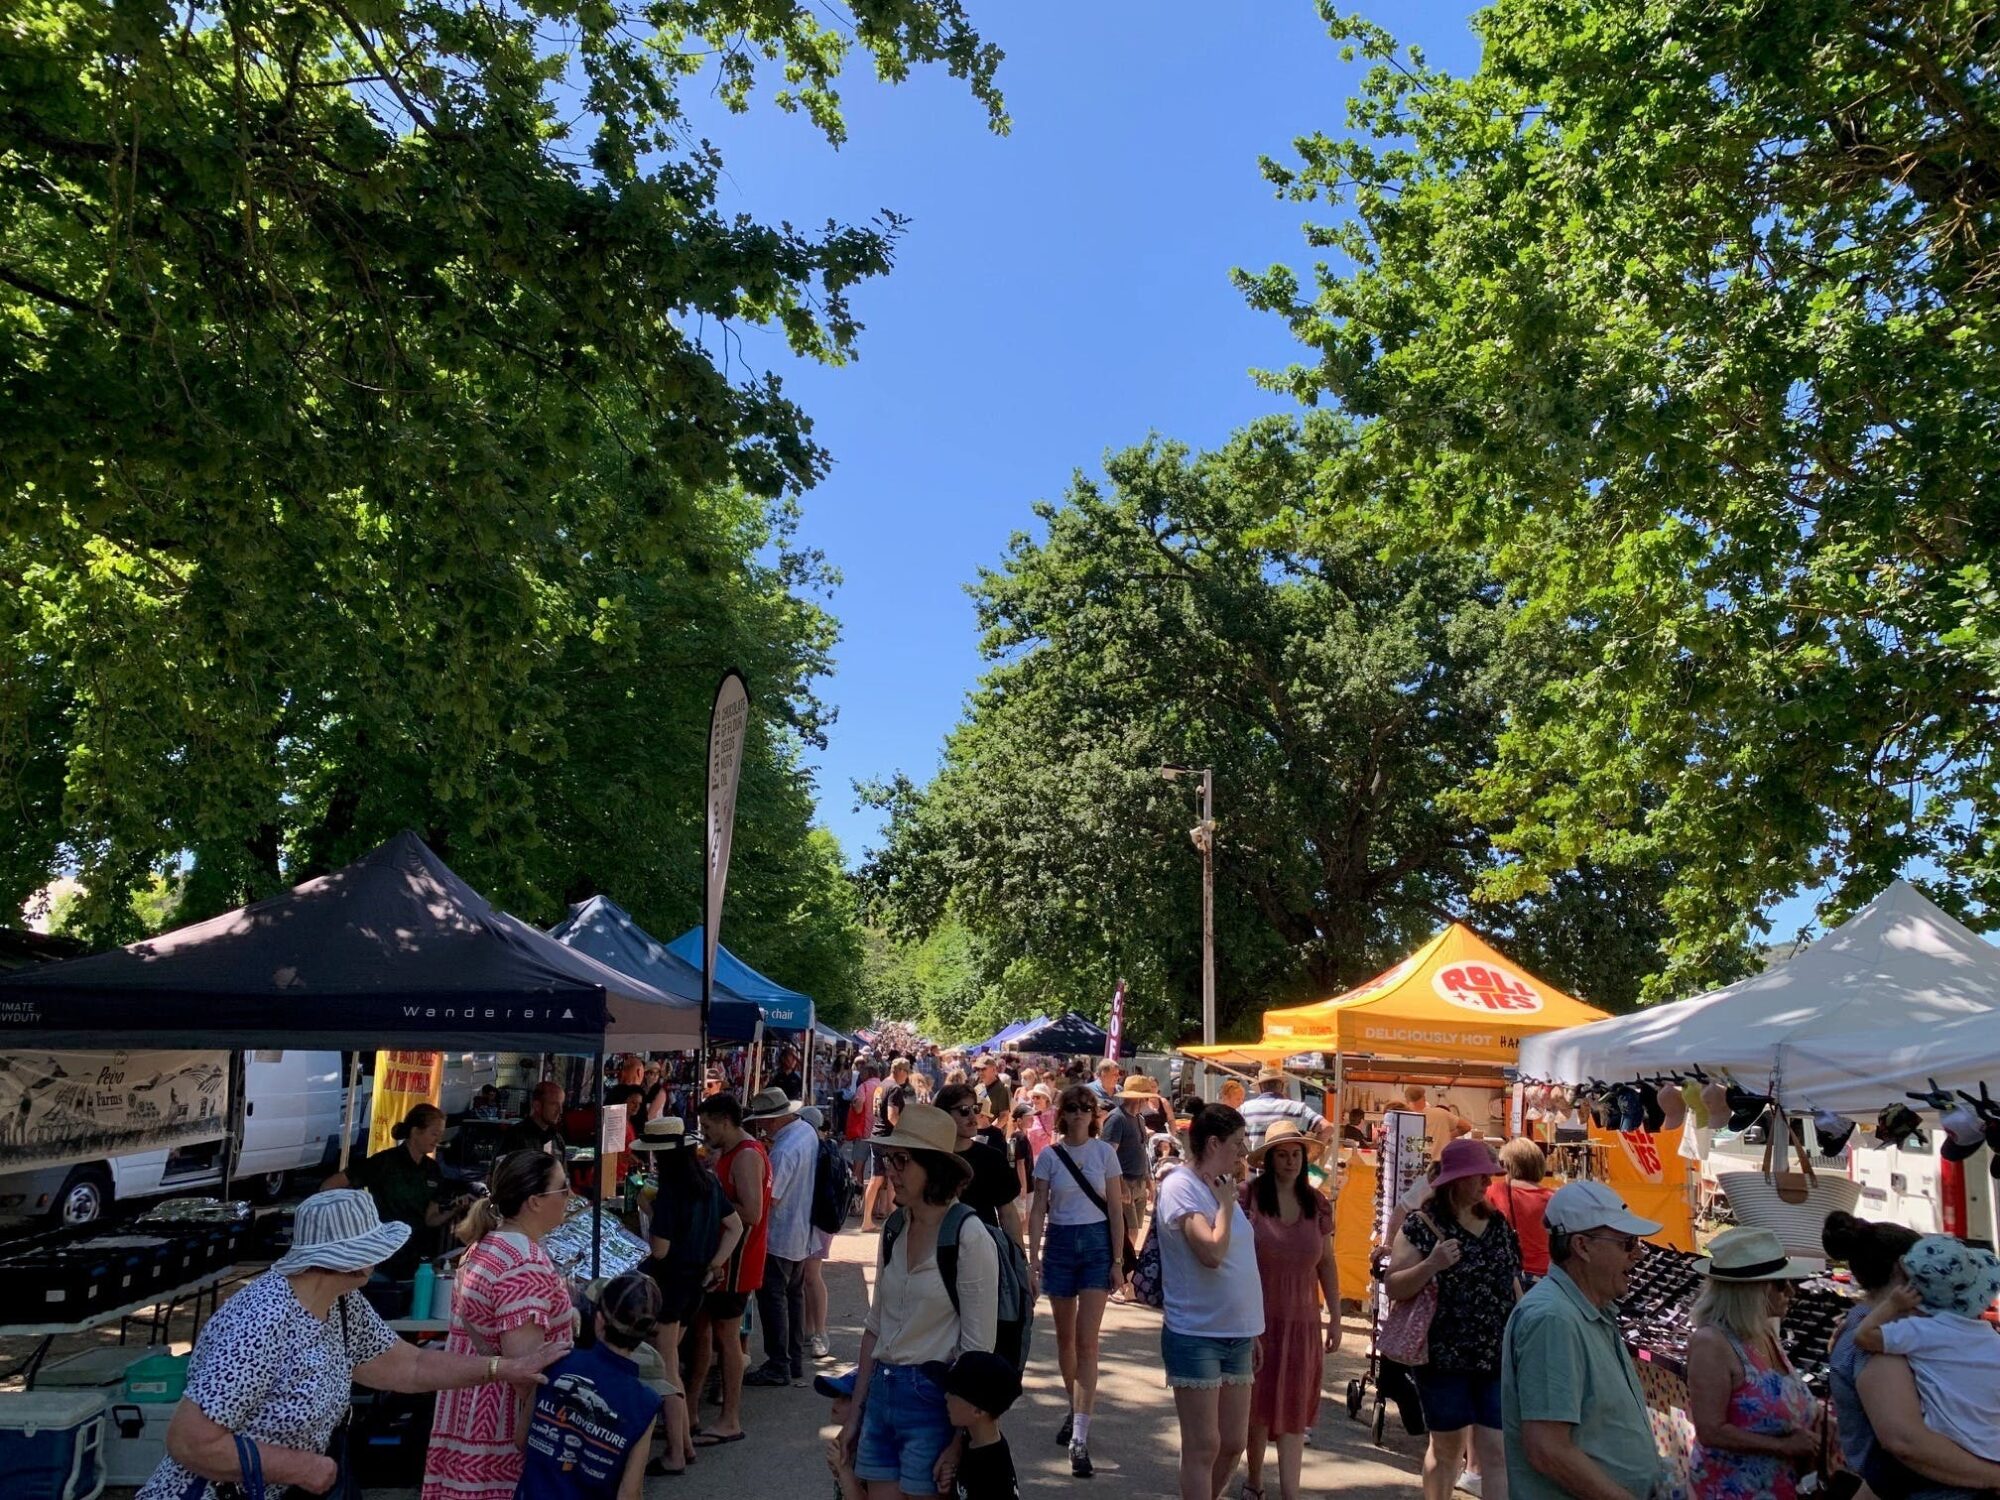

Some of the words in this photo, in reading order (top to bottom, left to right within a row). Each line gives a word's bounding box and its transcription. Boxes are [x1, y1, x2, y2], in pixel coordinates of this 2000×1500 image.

[0, 1002, 34, 1012] IMATE
[403, 1006, 551, 1018] Wanderer
[0, 1013, 41, 1022] VYDUTY
[771, 1008, 794, 1020] chair
[1365, 1027, 1458, 1045] DELICIOUSLY
[1462, 1033, 1493, 1046] HOT
[96, 1091, 123, 1107] Farms
[537, 1399, 556, 1416] ALL
[556, 1405, 567, 1423] 4
[568, 1411, 628, 1449] ADVENTURE
